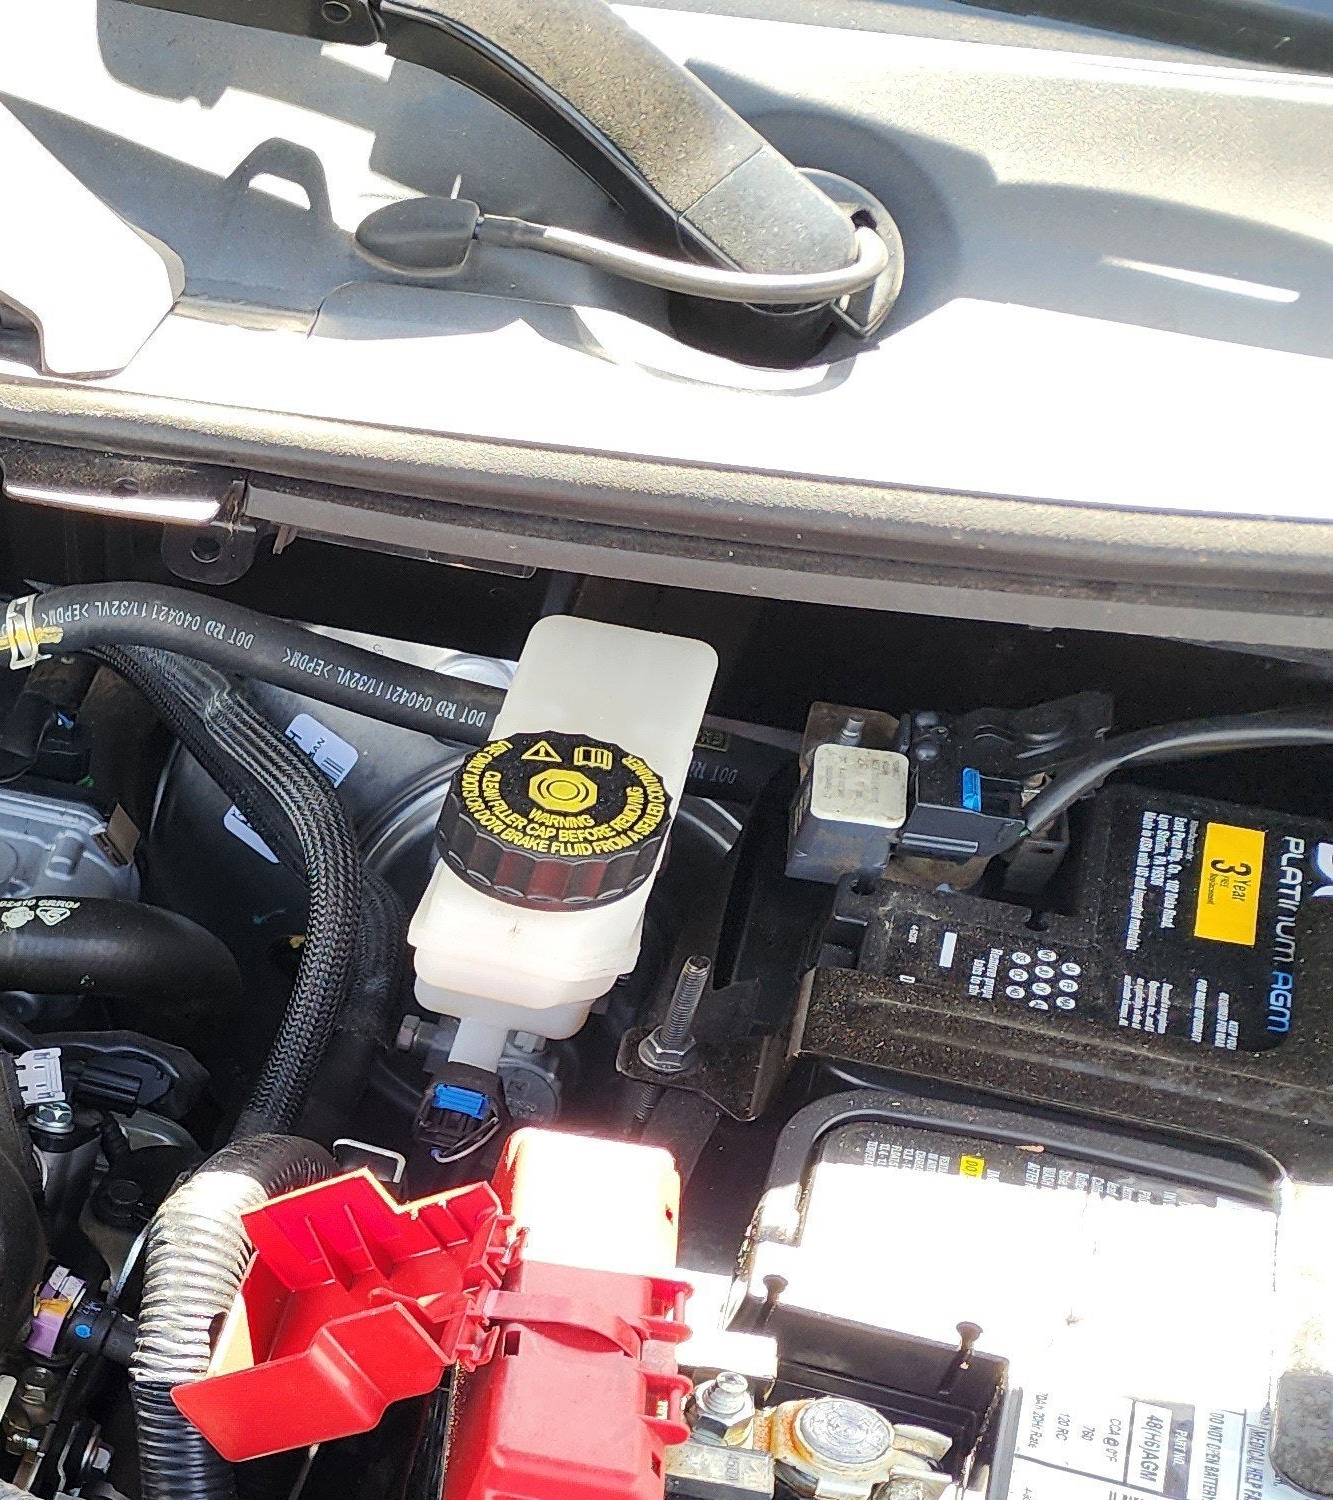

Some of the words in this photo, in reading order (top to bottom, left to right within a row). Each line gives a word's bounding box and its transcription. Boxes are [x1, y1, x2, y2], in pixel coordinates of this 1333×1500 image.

[150, 603, 202, 631] 040421
[226, 627, 255, 650] DOT
[383, 682, 434, 713] 040421
[458, 705, 487, 728] DOT
[483, 771, 501, 799] CLEAN
[622, 754, 665, 802] CONTAINER
[488, 797, 527, 829] FILLER
[528, 808, 595, 829] WARNING
[609, 786, 644, 832] REMOVING
[1140, 810, 1156, 829] Made
[634, 804, 665, 837] SEALED
[1172, 815, 1187, 831] East
[501, 826, 549, 852] BRAKE
[526, 824, 557, 840] CAP
[558, 825, 616, 842] BEFORE
[628, 829, 644, 843] A
[1168, 830, 1185, 849] Penn
[551, 841, 593, 856] FLUID
[594, 834, 633, 855] FROM
[1151, 854, 1166, 866] PA
[1209, 857, 1253, 877] 3
[1230, 877, 1252, 903] Year
[1266, 834, 1309, 964] PLATINUM
[985, 947, 1003, 978] Remove
[1263, 969, 1296, 1034] AGM
[1056, 1412, 1071, 1427] 120
[1106, 1417, 1122, 1436] CCA
[1208, 1411, 1225, 1424] DO
[1054, 1426, 1069, 1441] RC
[1080, 1425, 1096, 1442] 760
[1102, 1435, 1119, 1447] @
[1173, 1428, 1188, 1452] PART
[1206, 1424, 1224, 1443] NOT
[1133, 1413, 1165, 1482] 48(H6)AGM
[1172, 1450, 1186, 1466] NO.
[1203, 1442, 1222, 1465] OPEN
[1244, 1428, 1269, 1466] MEDICAL
[1243, 1466, 1265, 1489] HELP
